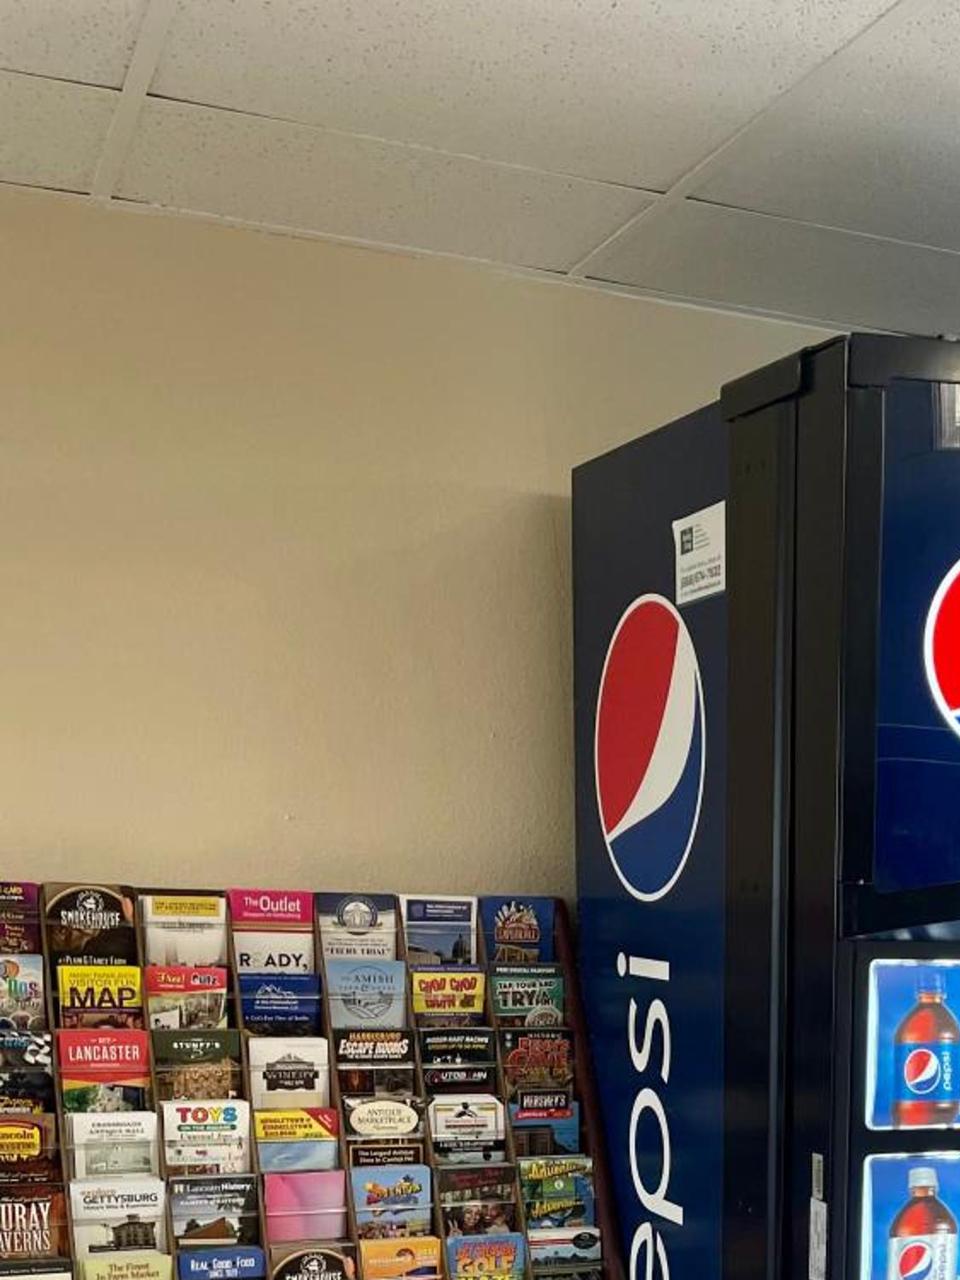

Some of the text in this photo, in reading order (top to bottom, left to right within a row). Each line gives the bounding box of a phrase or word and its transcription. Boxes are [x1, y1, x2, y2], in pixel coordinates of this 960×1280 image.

[244, 895, 301, 913] The Outlet
[68, 987, 137, 1008] MAP
[498, 991, 536, 1007] TRY
[68, 1045, 140, 1062] LANCASTER
[942, 1051, 953, 1091] pepsi
[522, 1094, 567, 1108] HERSHEY'S
[176, 1106, 238, 1123] TOYS
[82, 1192, 158, 1205] GETTYSBURG
[109, 1262, 150, 1273] The Finest
[190, 1259, 208, 1271] REAL
